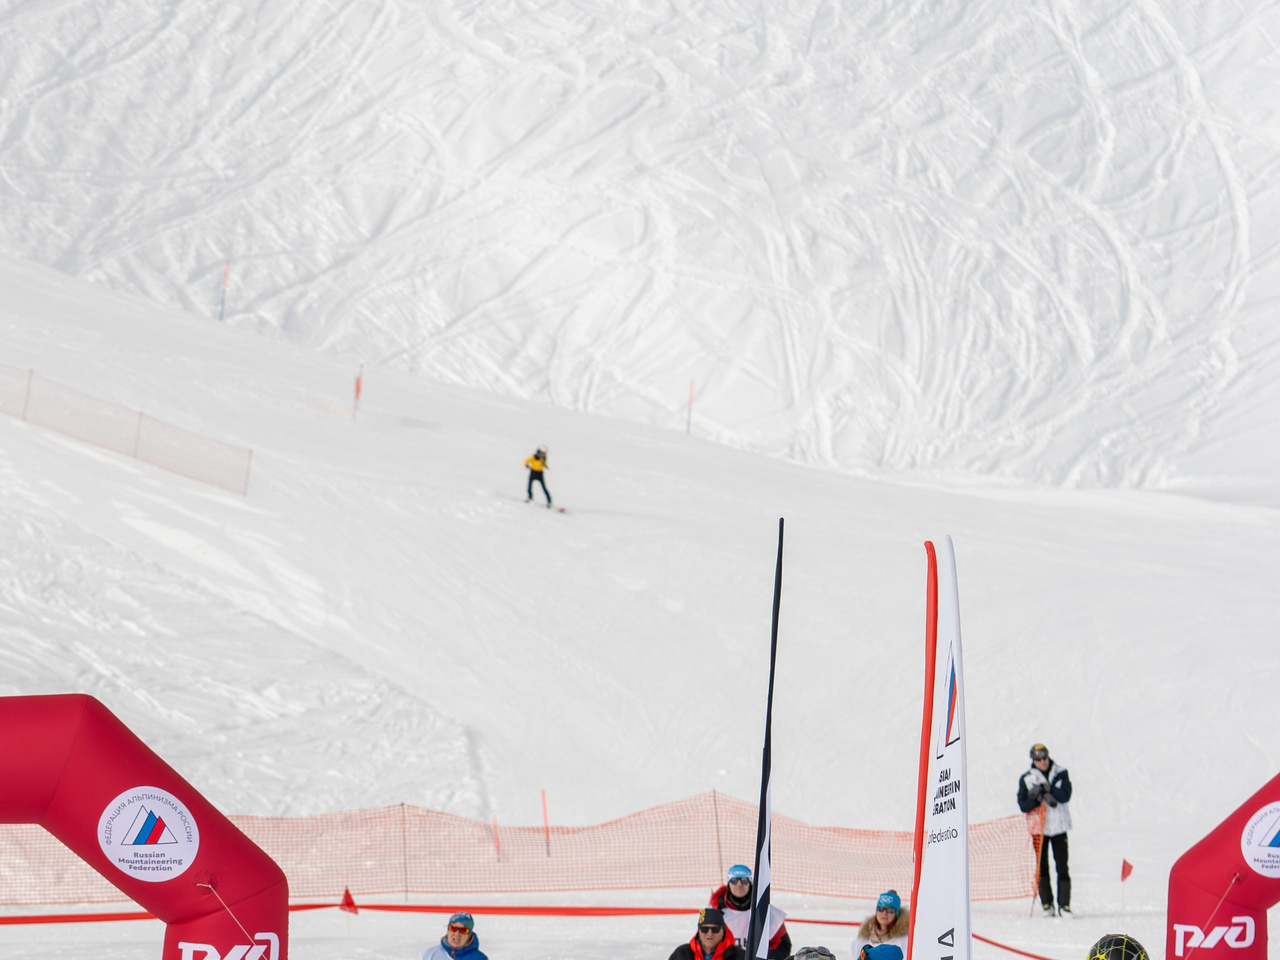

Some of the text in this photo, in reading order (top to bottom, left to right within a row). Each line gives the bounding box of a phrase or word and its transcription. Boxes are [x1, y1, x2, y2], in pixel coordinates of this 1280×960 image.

[104, 793, 193, 845] ФЕДЕРАЦИЯ АЛЬПИНИЗМА РОССИИ
[118, 857, 183, 866] Mountaineering
